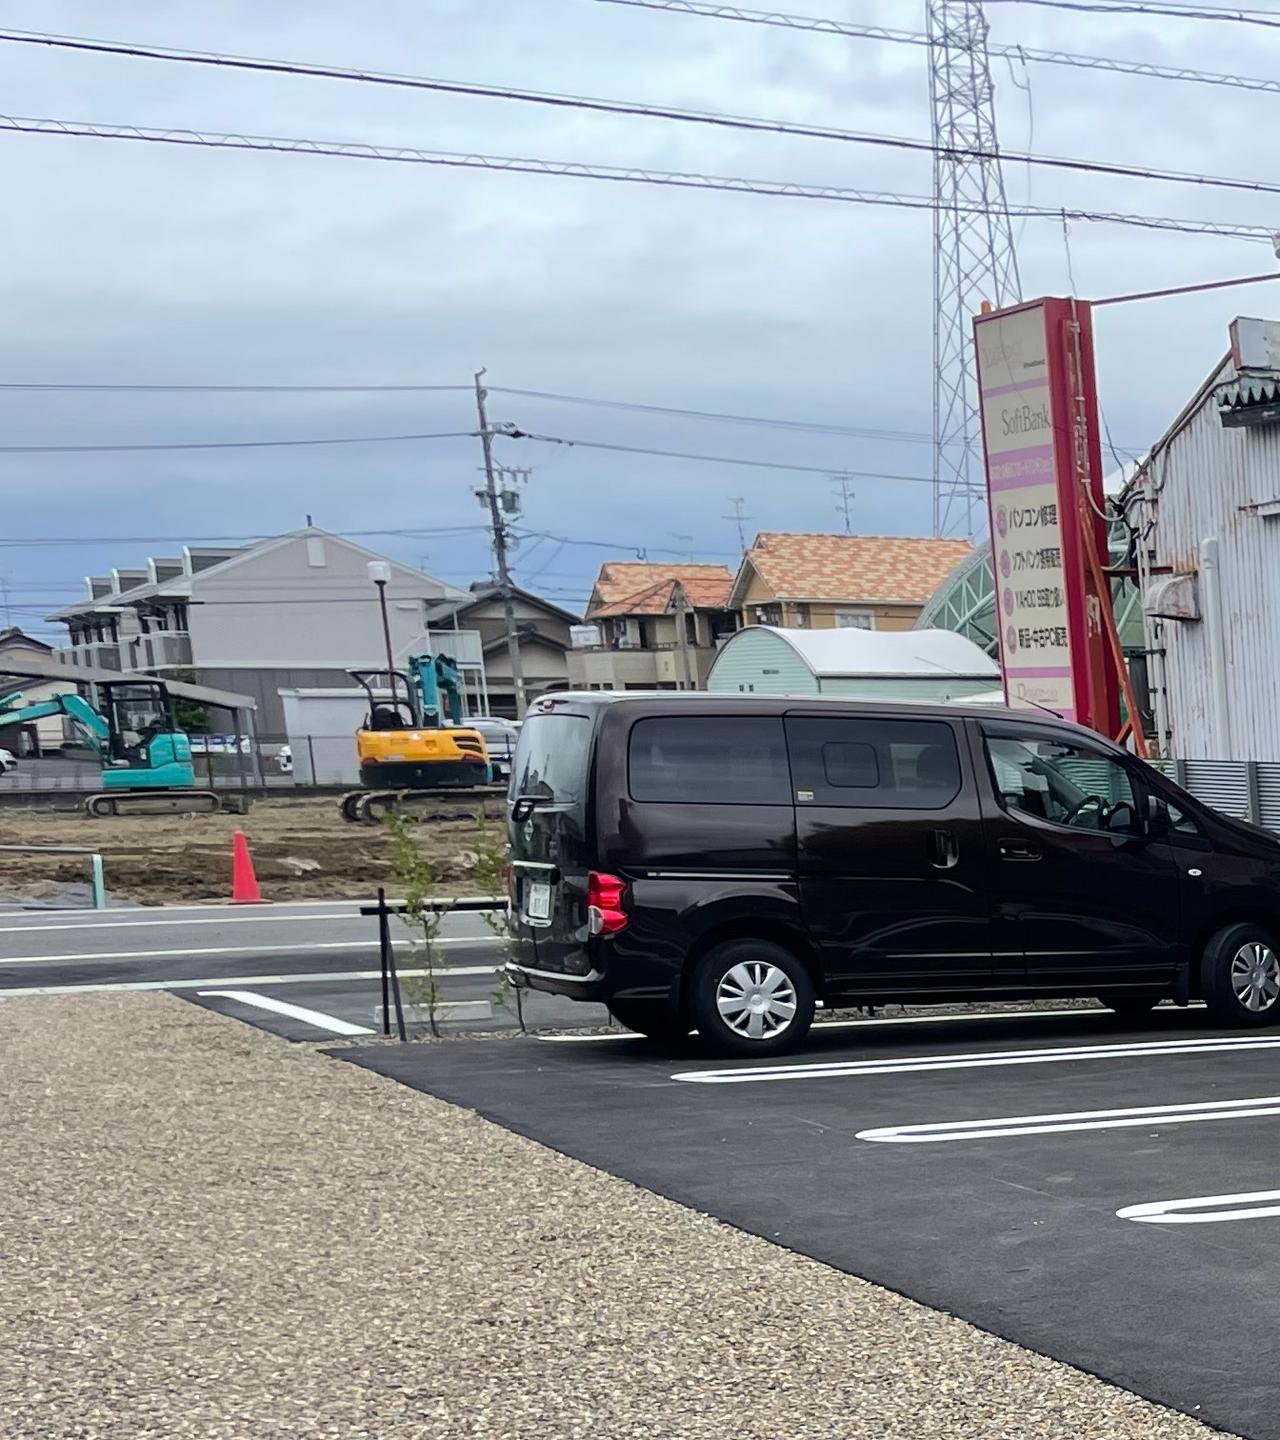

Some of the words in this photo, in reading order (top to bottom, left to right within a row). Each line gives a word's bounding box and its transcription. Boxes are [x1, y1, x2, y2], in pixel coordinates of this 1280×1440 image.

[1001, 404, 1051, 436] SoftBank
[1009, 504, 1058, 528] パソコン修理
